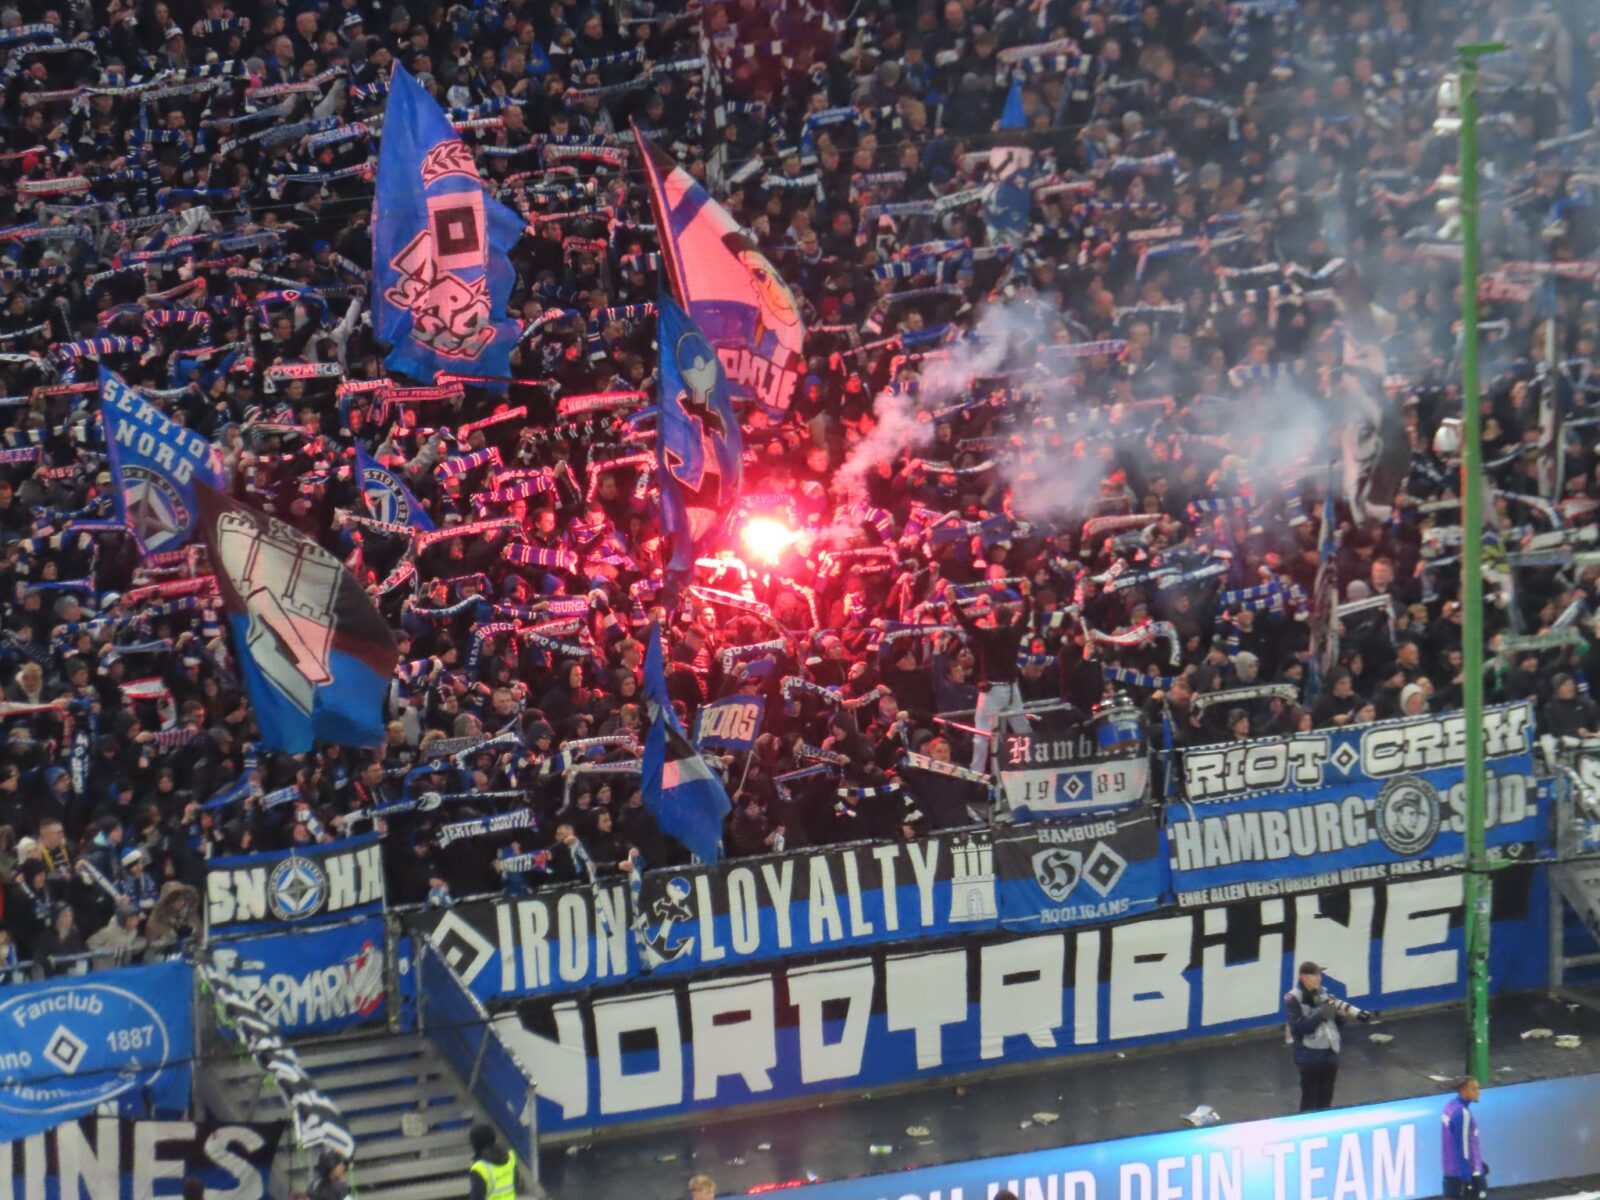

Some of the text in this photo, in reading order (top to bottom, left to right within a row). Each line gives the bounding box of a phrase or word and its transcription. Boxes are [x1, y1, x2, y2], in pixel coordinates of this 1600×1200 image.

[115, 419, 194, 485] NORD
[1008, 733, 1141, 766] Hamb
[1186, 738, 1327, 799] RIOT
[1024, 771, 1127, 800] 19 89
[1038, 820, 1117, 844] HAMBURG
[1174, 796, 1368, 872] HAMBURG
[207, 868, 267, 925] SN
[324, 844, 383, 911] HH
[695, 838, 940, 962] LOYALTY
[1040, 897, 1130, 925] HOOLIGANS
[1210, 883, 1246, 904] ALLEN
[498, 886, 628, 992] IRON
[13, 991, 103, 1028] Fanclub
[492, 875, 1464, 1120] NORDTRIBÜNE
[107, 1025, 154, 1052] 1887
[1264, 1124, 1416, 1200] TEAM
